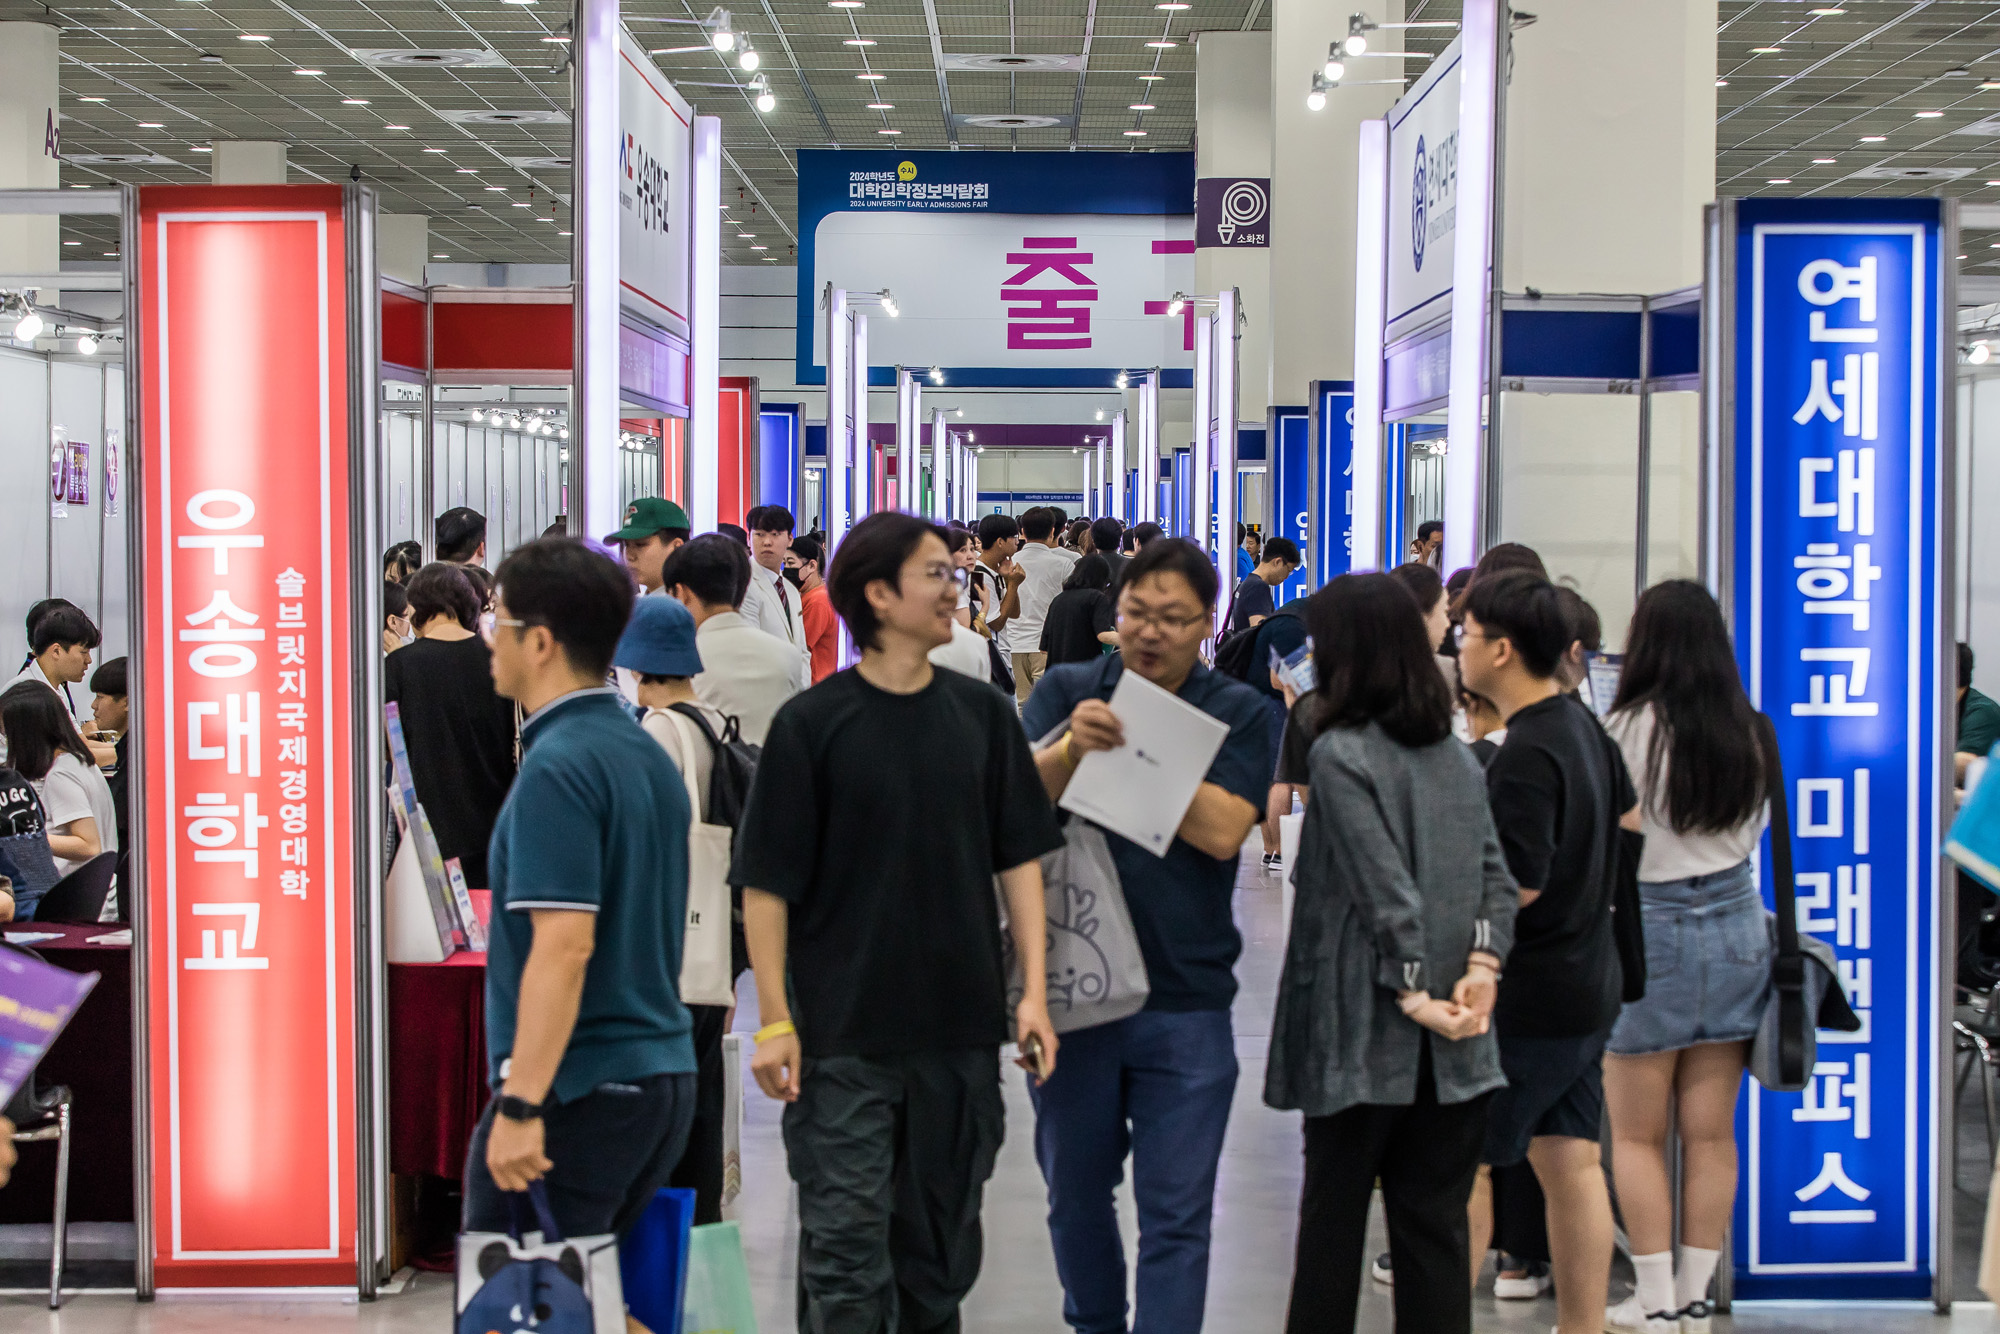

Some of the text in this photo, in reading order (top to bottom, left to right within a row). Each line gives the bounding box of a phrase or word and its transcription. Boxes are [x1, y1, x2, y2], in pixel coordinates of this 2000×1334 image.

[849, 171, 896, 182] 2024학년도
[900, 166, 914, 175] 수시
[636, 143, 669, 235] 우송대학교
[849, 182, 989, 200] 대학입학정보박람회
[866, 200, 906, 208] UNIVERSITY
[929, 201, 971, 209] ADMISSIONS
[972, 201, 989, 209] FAIR
[1236, 233, 1265, 245] 소화전
[1790, 255, 1882, 717] 연세대학교
[177, 488, 270, 970] 우송대학교
[274, 566, 311, 900] 솔브릿지국제경영대학
